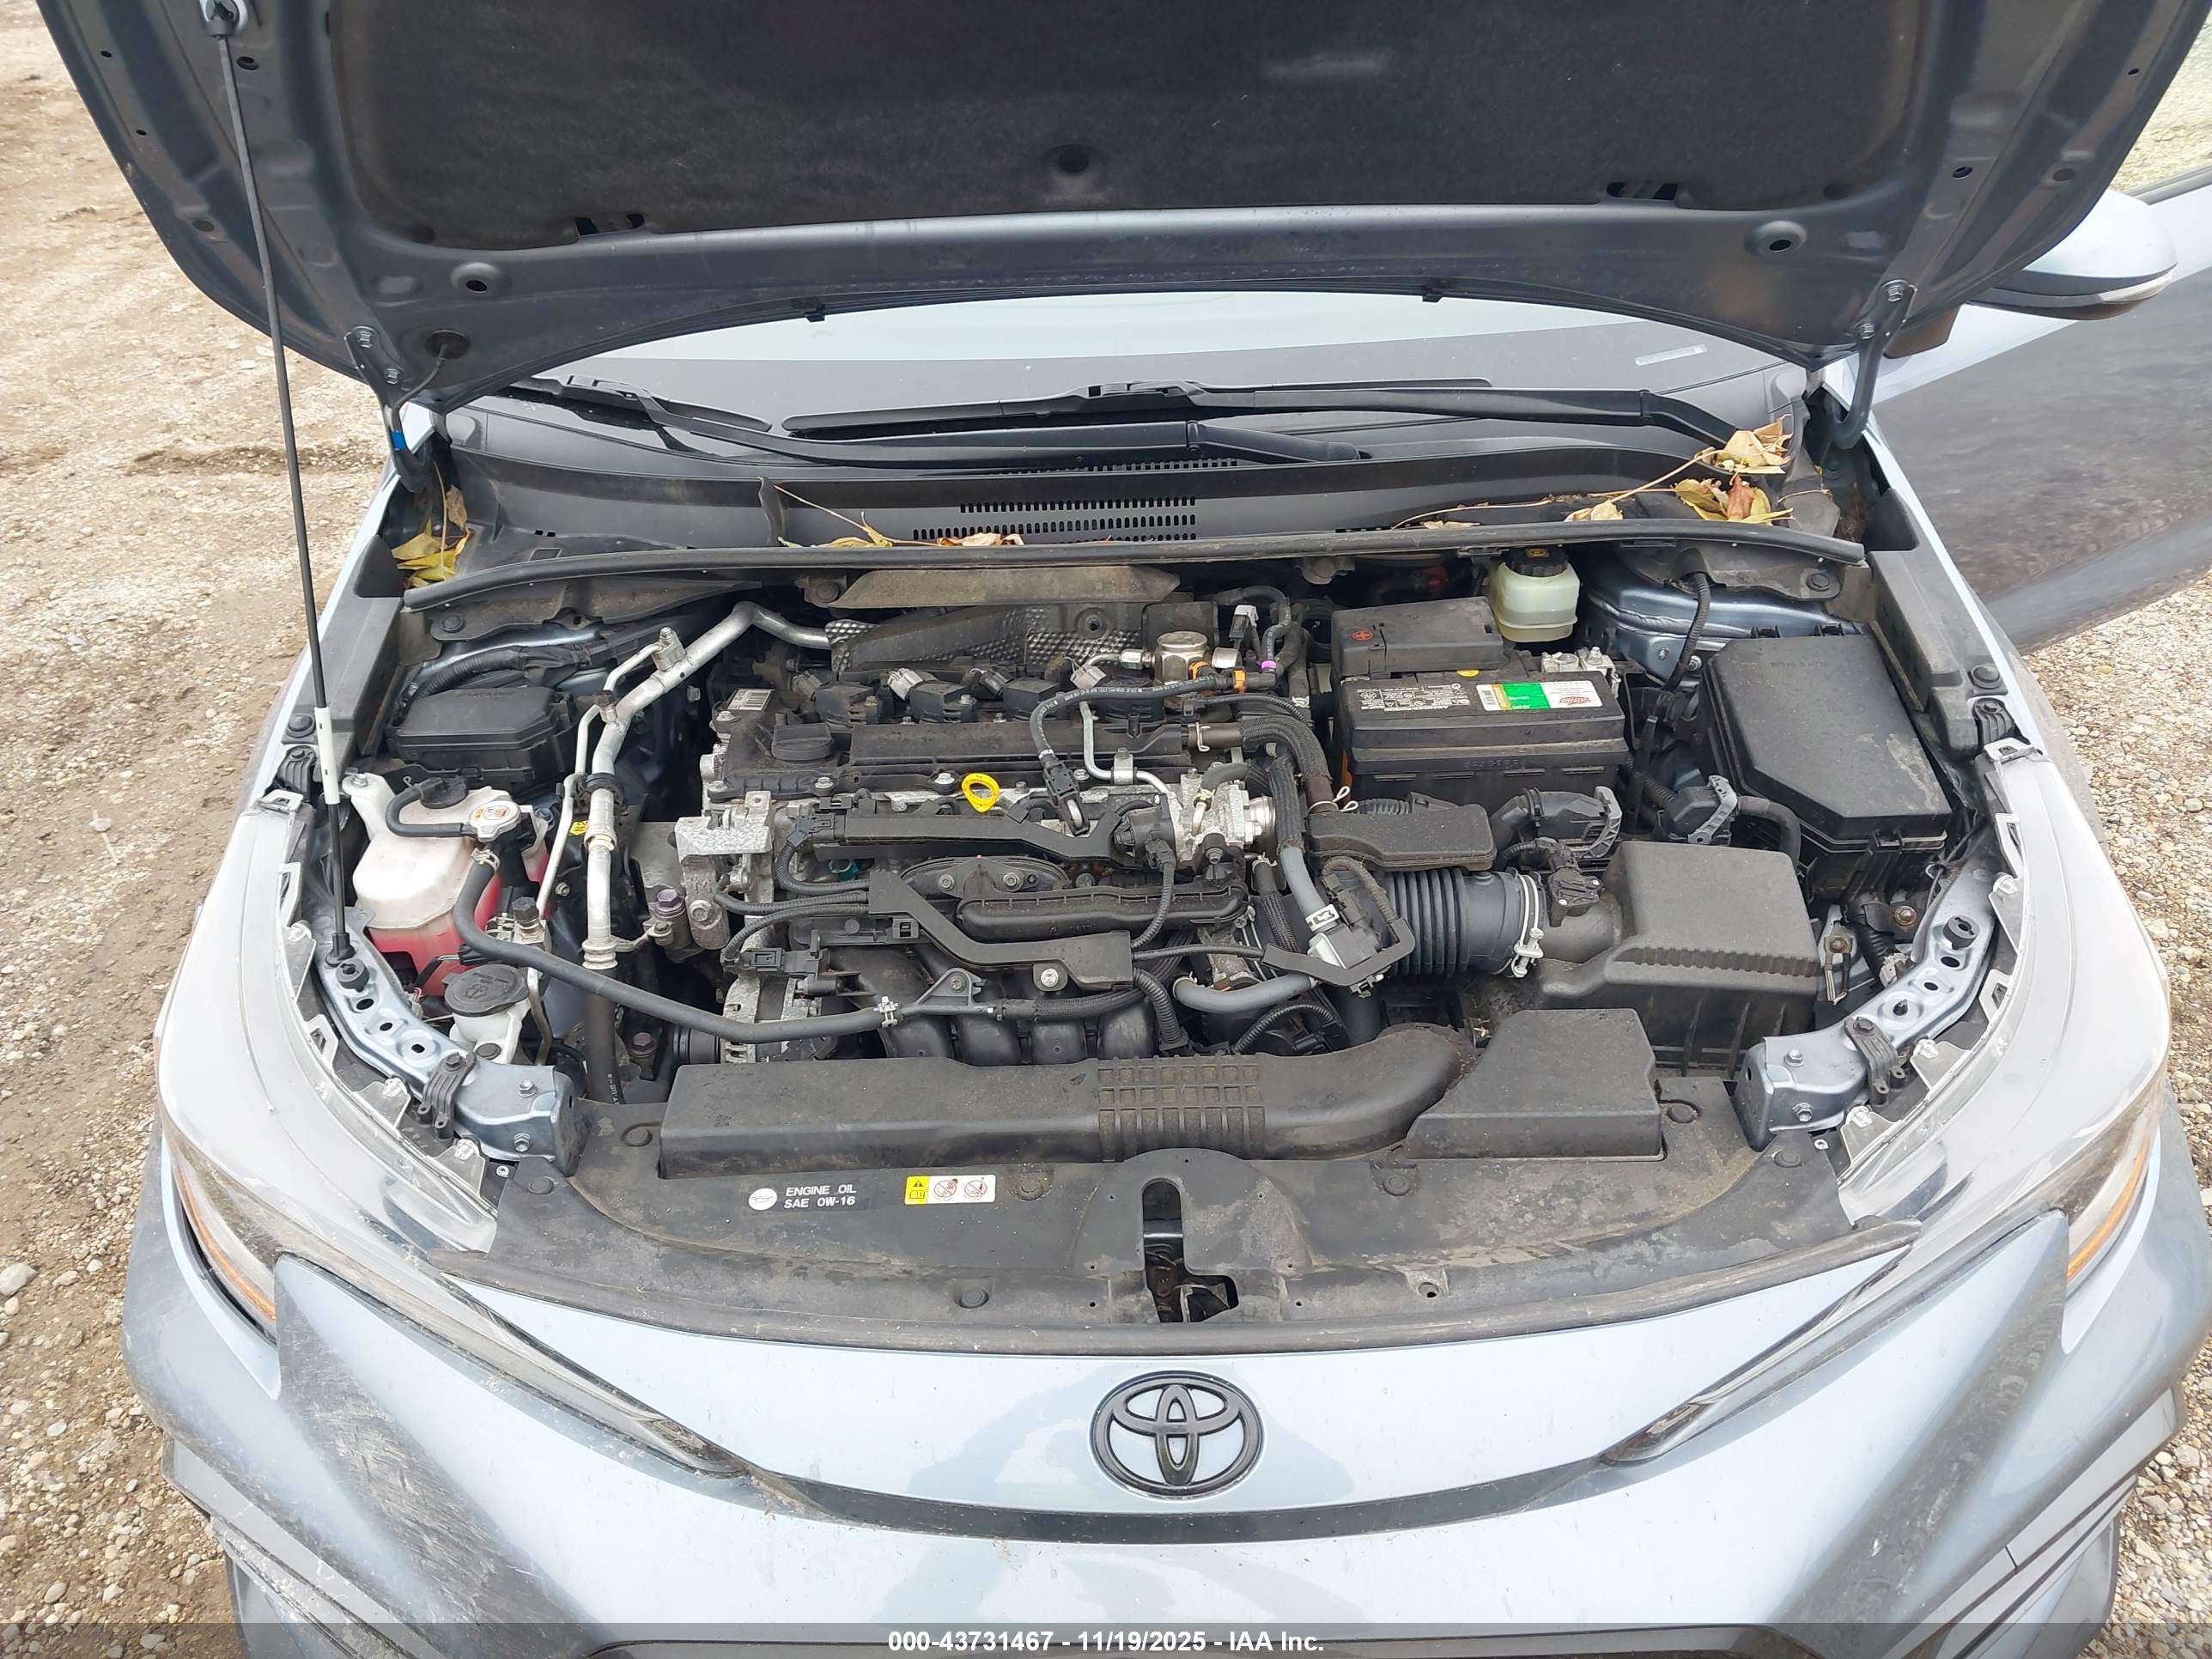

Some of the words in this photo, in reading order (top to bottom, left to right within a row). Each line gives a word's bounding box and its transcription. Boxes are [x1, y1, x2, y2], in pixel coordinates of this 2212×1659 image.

[786, 1185, 830, 1196] ENGINE
[838, 1184, 857, 1194] OIL
[784, 1198, 810, 1209] SAE
[817, 1196, 856, 1207] 0W-16
